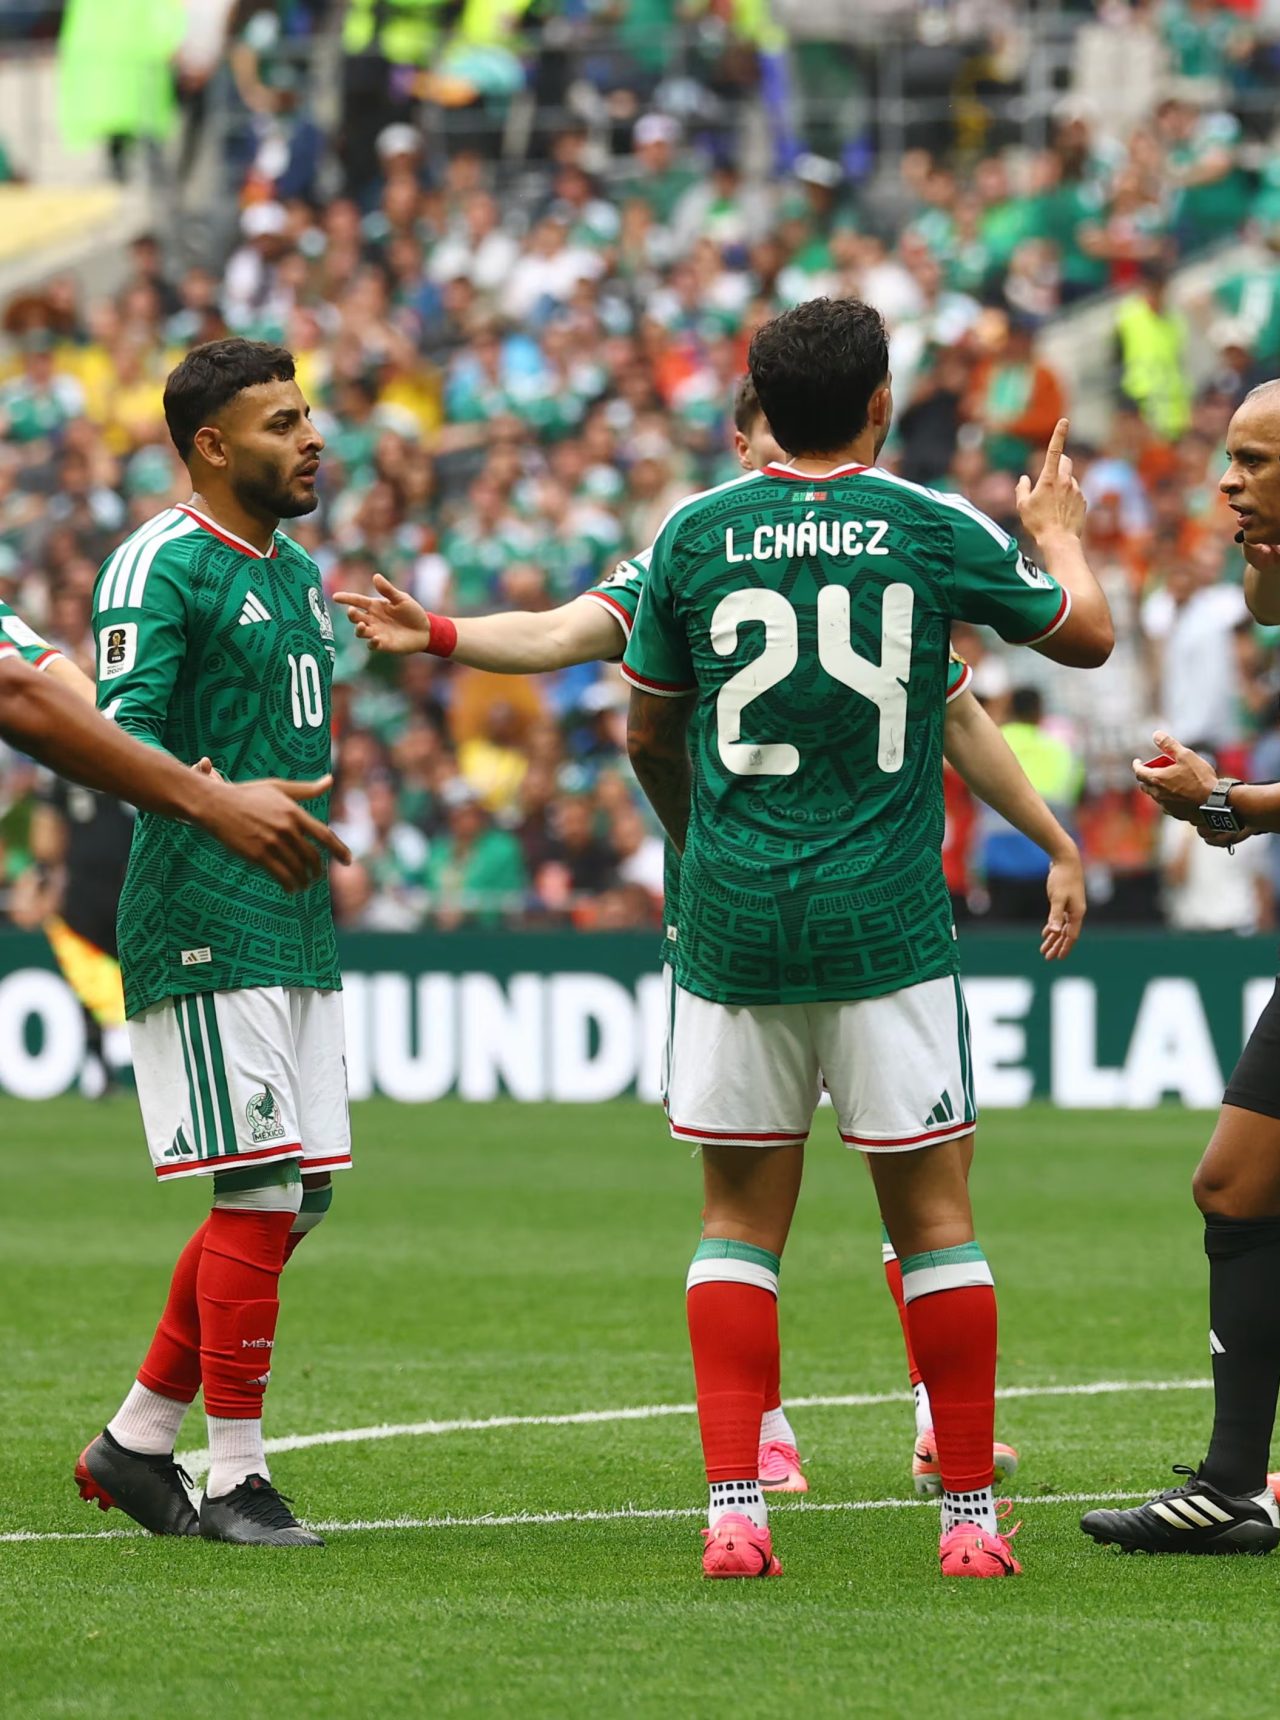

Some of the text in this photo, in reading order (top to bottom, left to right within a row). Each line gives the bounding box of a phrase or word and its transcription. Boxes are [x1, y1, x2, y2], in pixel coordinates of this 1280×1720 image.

[725, 511, 889, 563] L.CHÁVEZ
[287, 653, 324, 729] 10
[709, 583, 914, 776] 24
[1052, 976, 1226, 1110] LA
